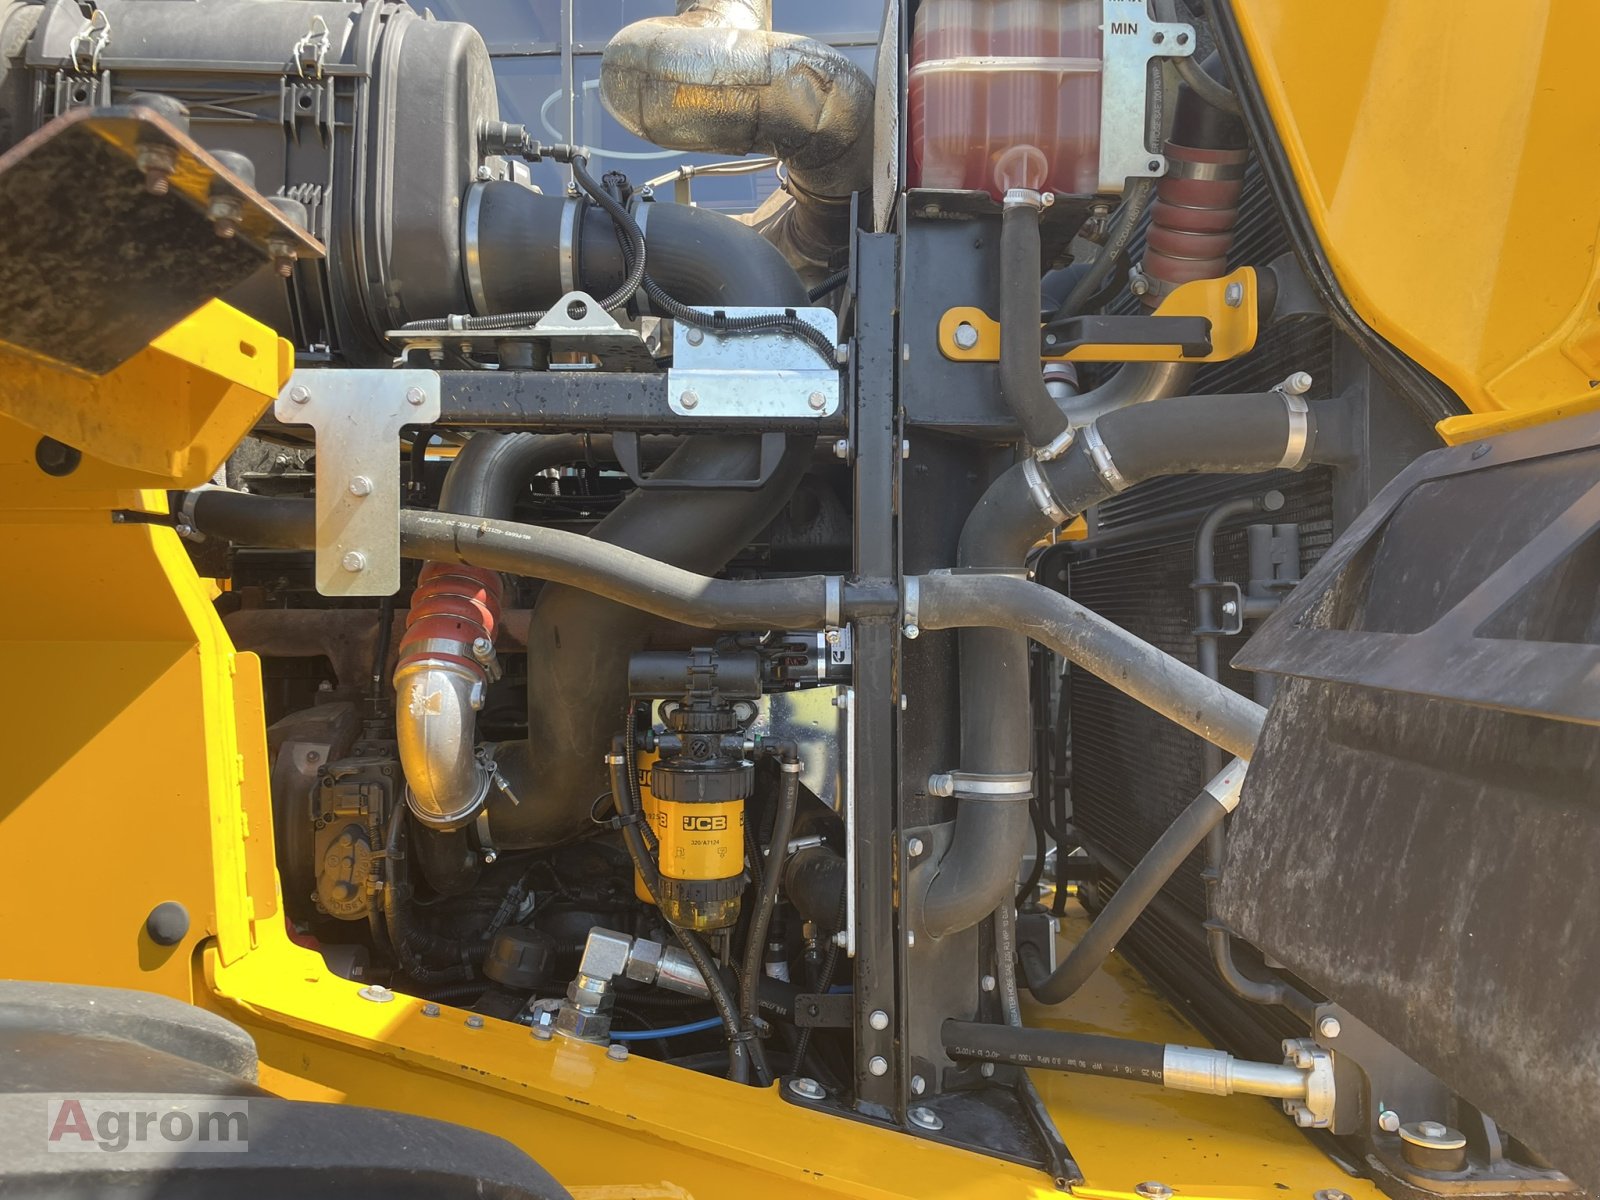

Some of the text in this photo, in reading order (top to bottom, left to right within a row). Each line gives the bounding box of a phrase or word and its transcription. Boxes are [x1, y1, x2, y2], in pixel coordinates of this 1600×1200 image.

[1111, 22, 1138, 34] MIN
[684, 816, 726, 830] JCB
[1152, 1070, 1162, 1078] DN
